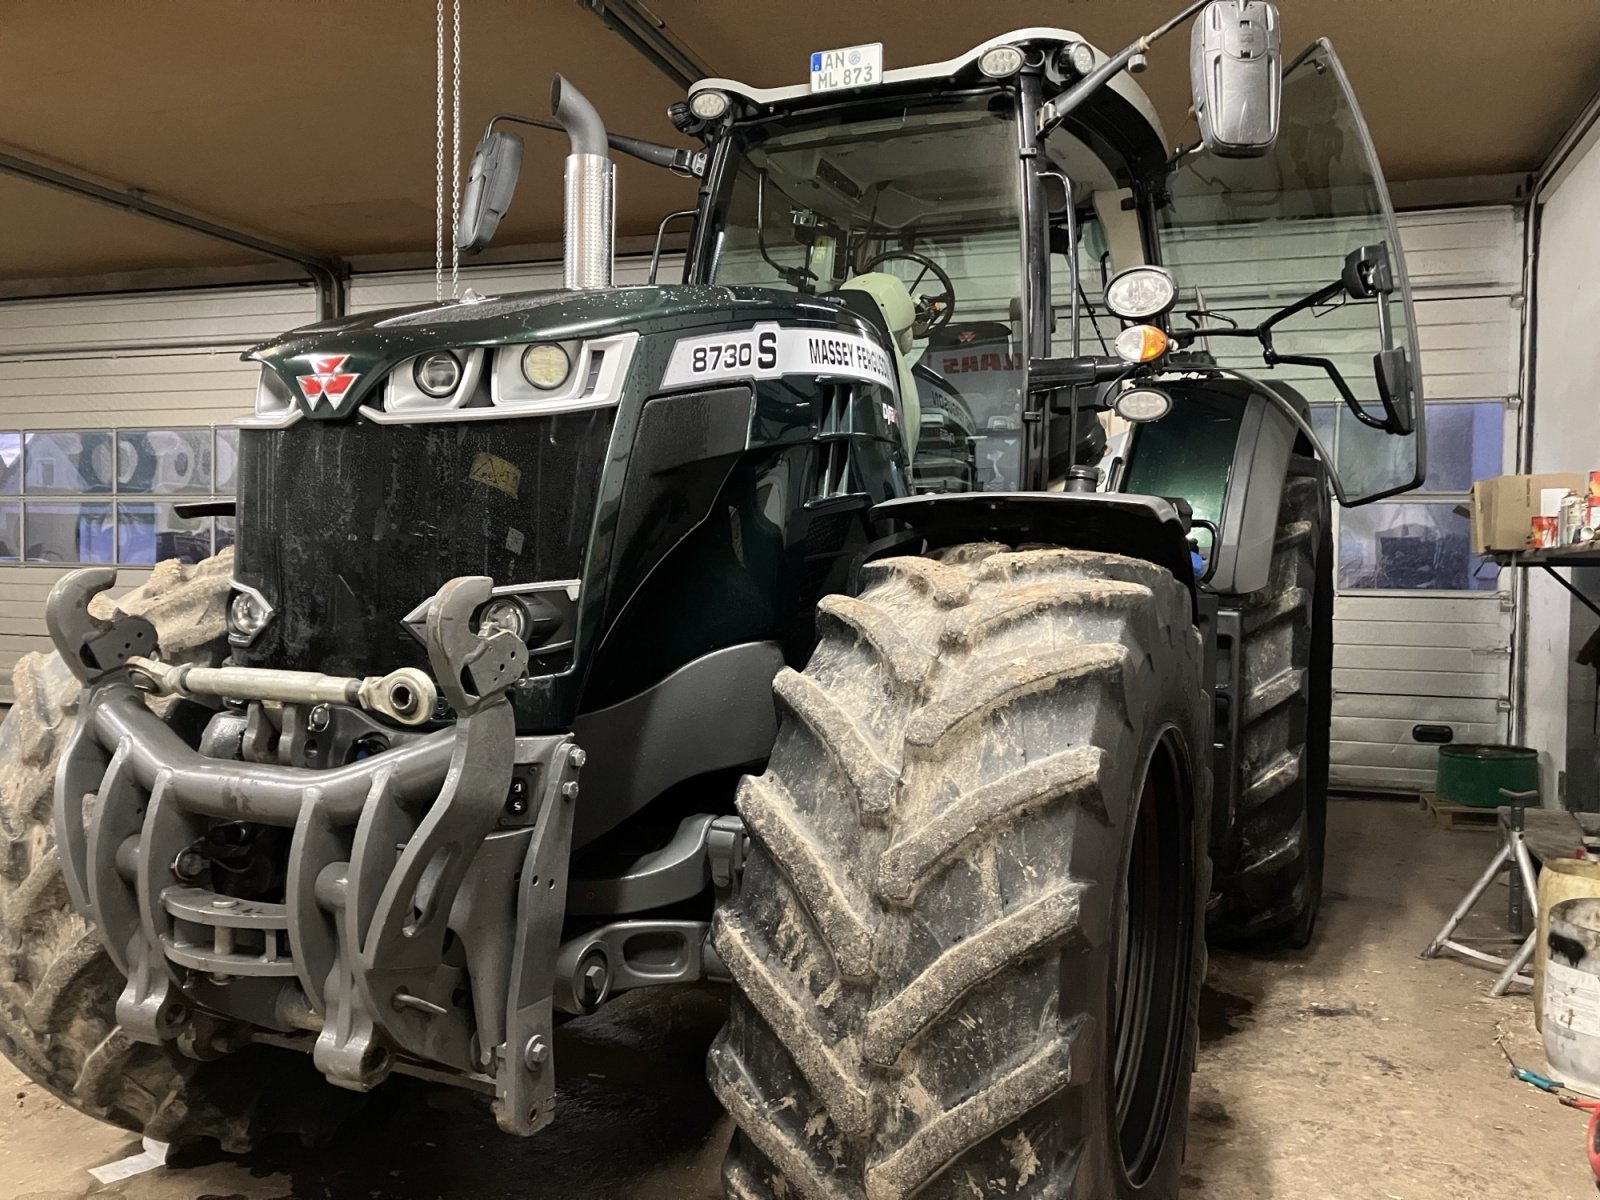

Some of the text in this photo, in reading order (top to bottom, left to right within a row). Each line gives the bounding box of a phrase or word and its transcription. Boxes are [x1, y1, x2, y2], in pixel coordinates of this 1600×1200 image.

[825, 51, 844, 70] AN
[818, 66, 872, 89] ML 873
[692, 343, 752, 373] 8730
[757, 332, 777, 370] S
[808, 337, 854, 367] MASSEY
